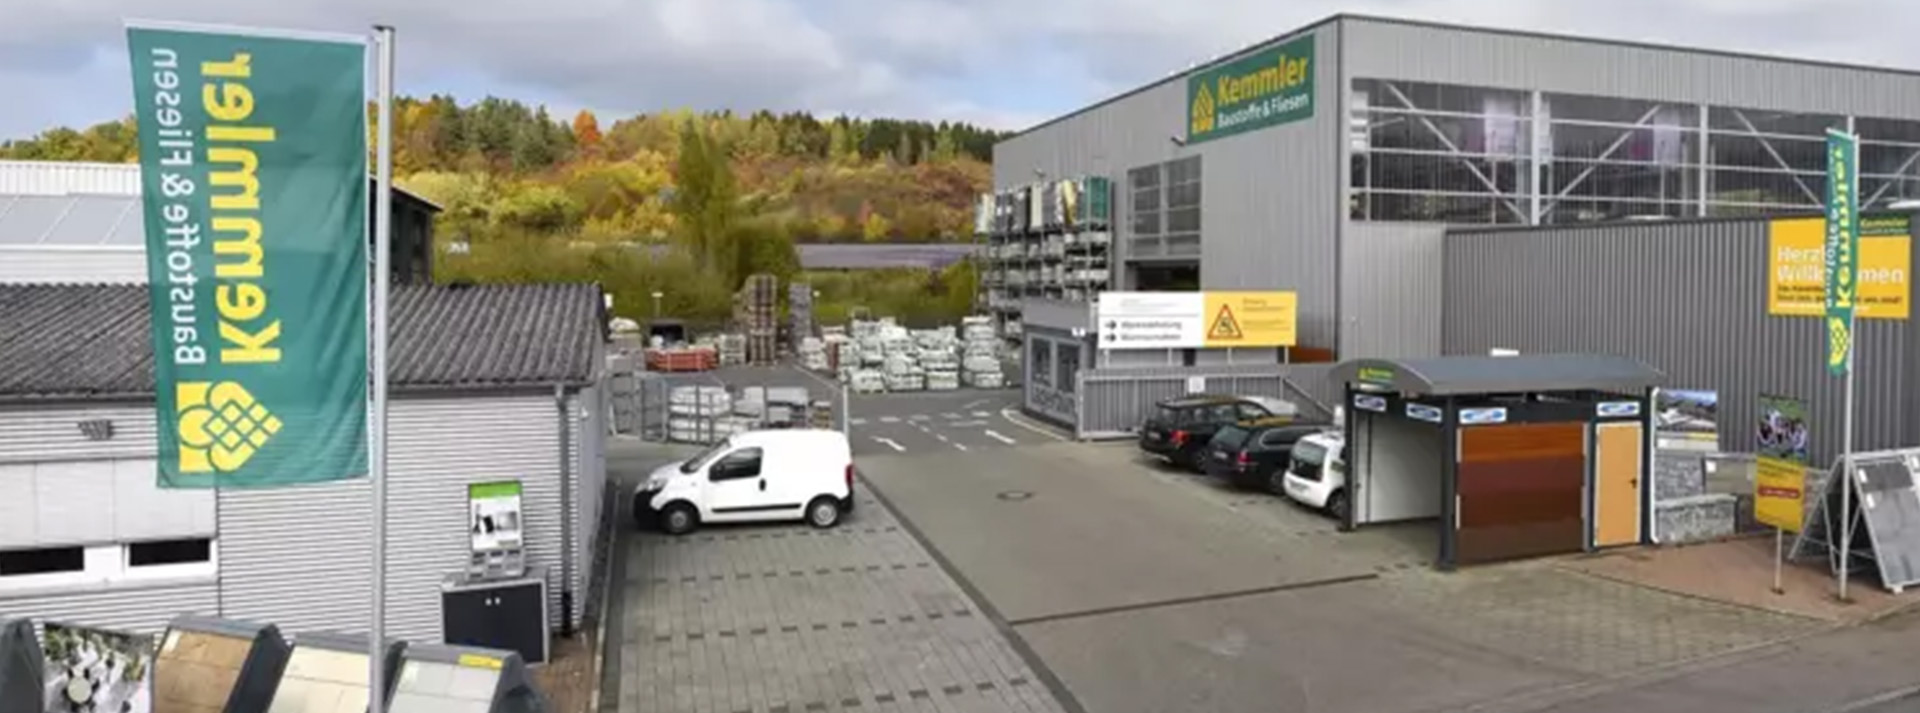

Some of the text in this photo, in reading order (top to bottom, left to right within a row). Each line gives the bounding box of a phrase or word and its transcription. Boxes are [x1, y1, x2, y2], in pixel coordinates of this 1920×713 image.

[1217, 54, 1308, 107] Kemmler
[1218, 103, 1261, 128] Baustoffe
[1271, 93, 1309, 114] Fliesen
